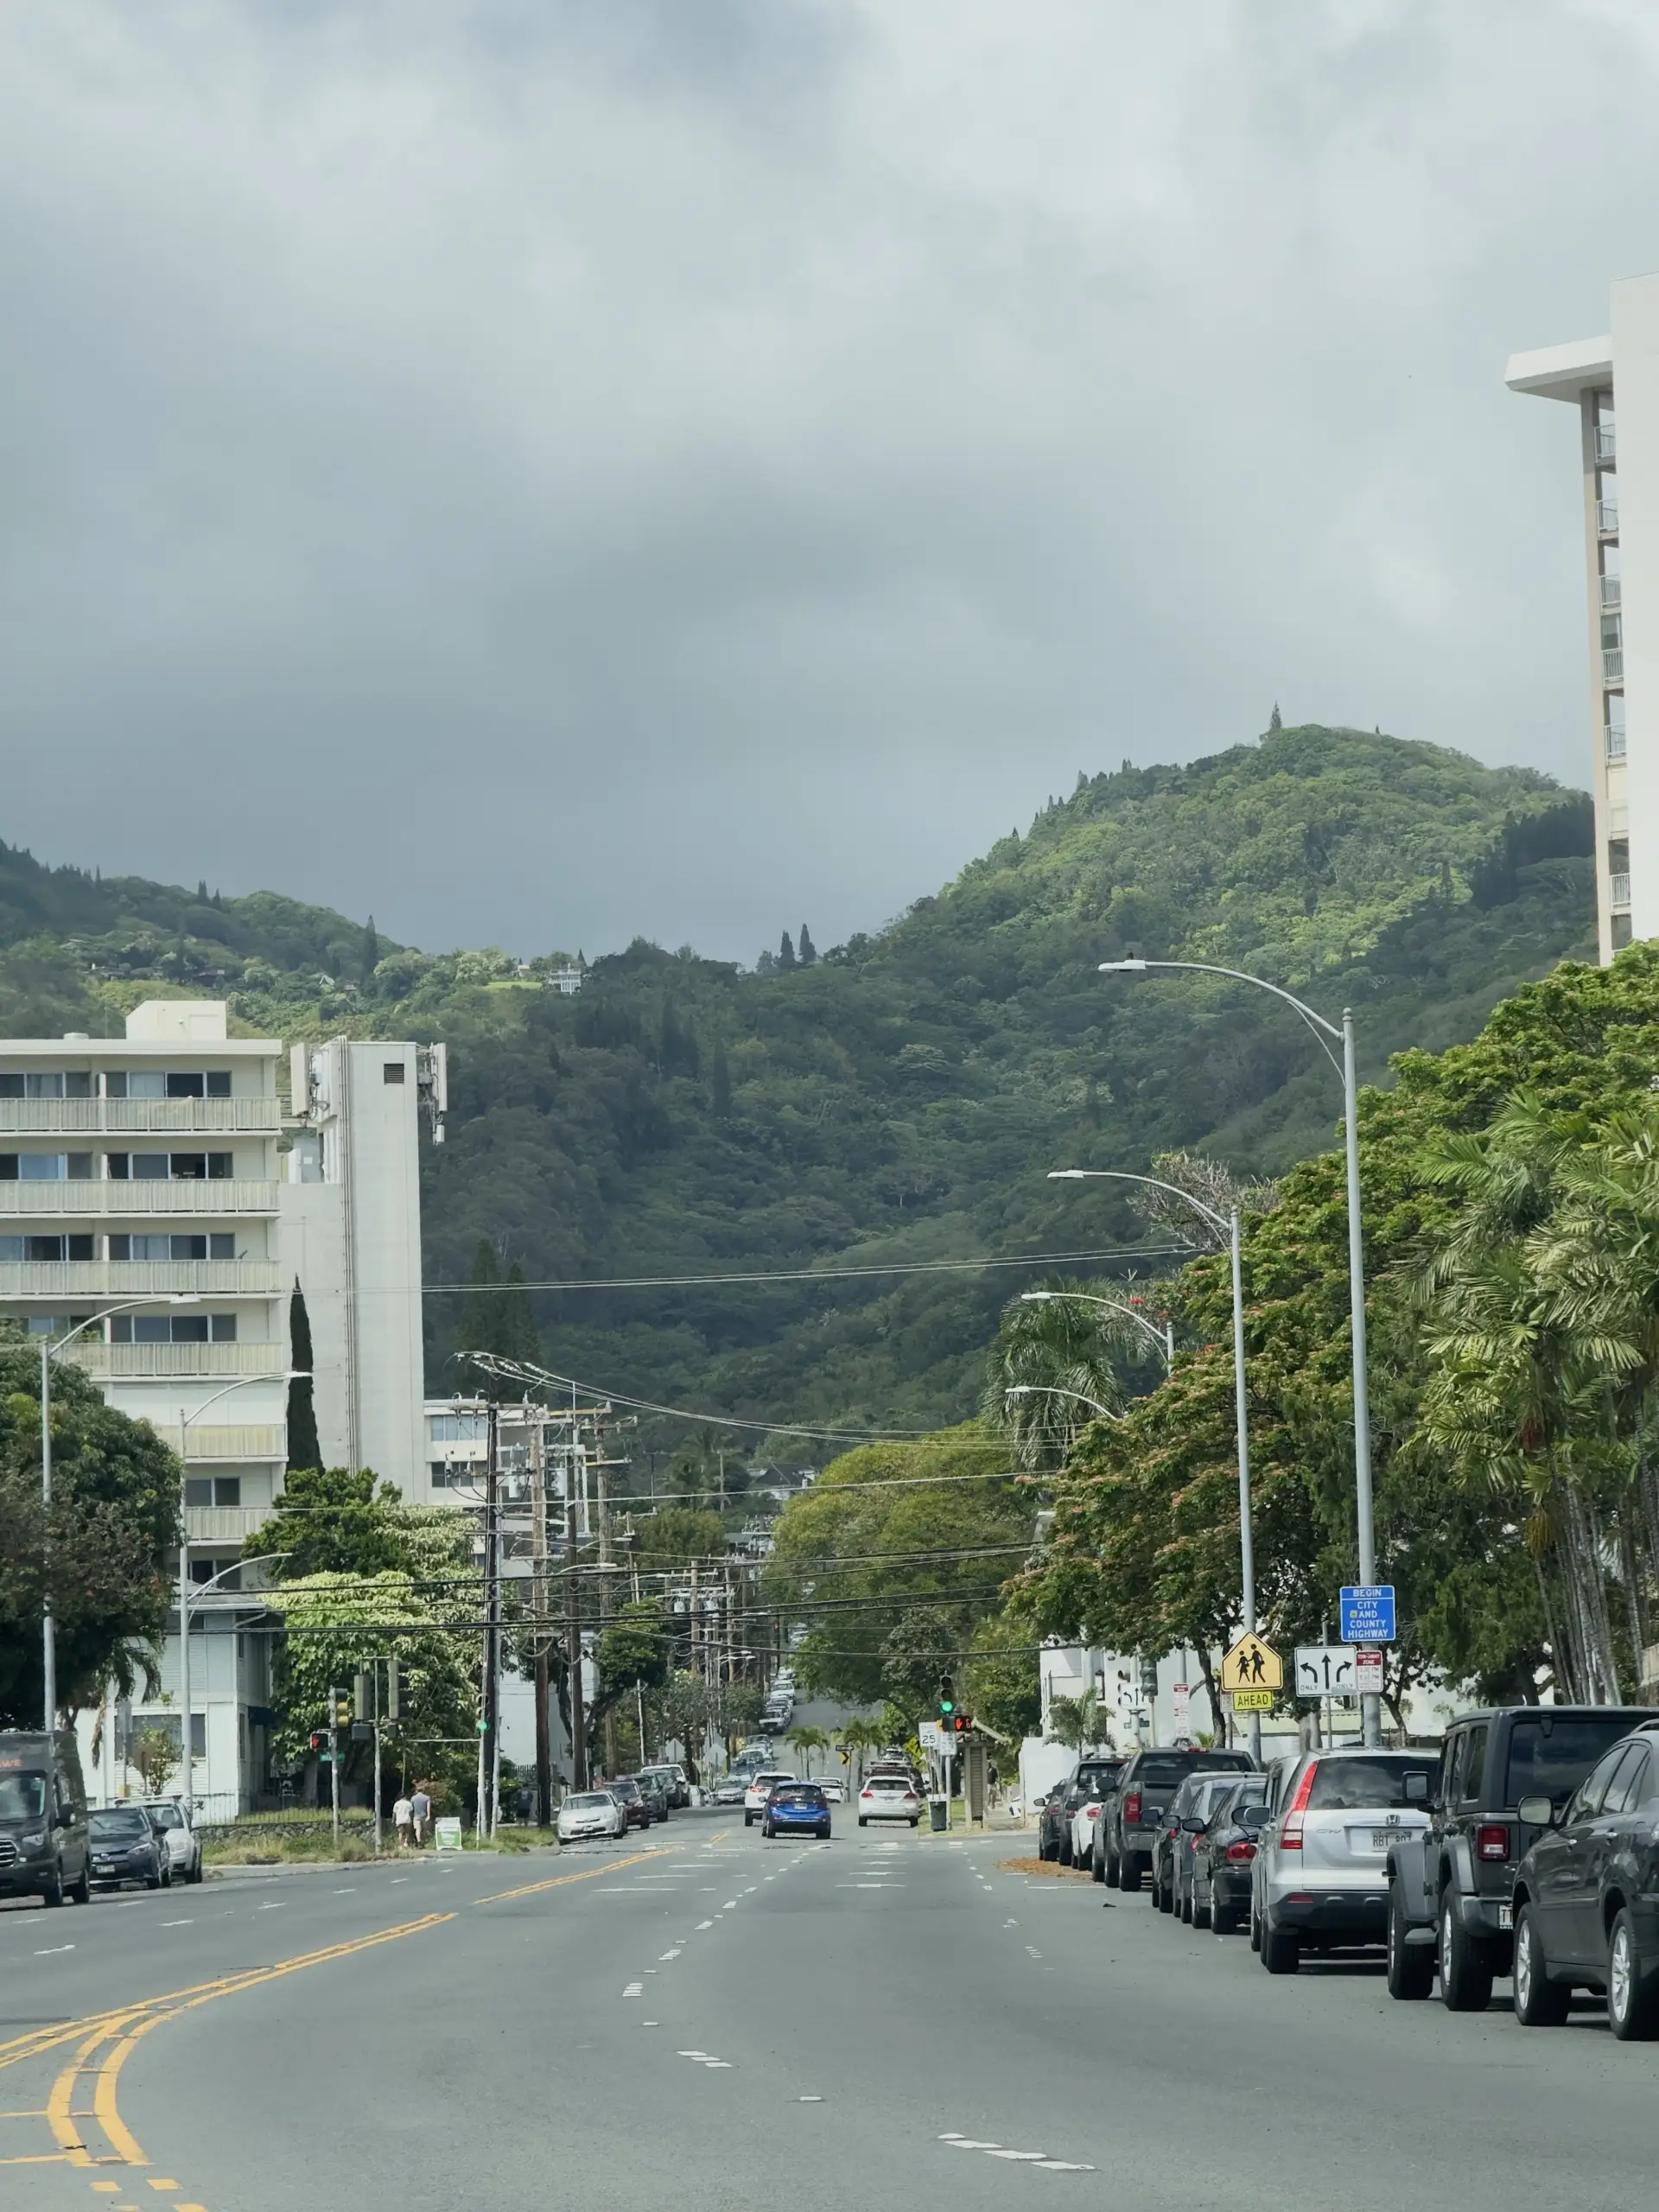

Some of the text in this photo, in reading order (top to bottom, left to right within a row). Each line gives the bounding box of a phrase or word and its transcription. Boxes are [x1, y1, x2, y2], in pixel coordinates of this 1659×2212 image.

[1352, 1588, 1382, 1598] BEGIN
[1357, 1600, 1378, 1610] CITY
[1357, 1610, 1378, 1618] AND
[1350, 1619, 1387, 1629] COUNTY
[1348, 1628, 1389, 1639] HIGHWAY
[1237, 1694, 1268, 1707] AHEAD
[922, 1734, 936, 1745] 25
[1373, 1834, 1389, 1847] RBT
